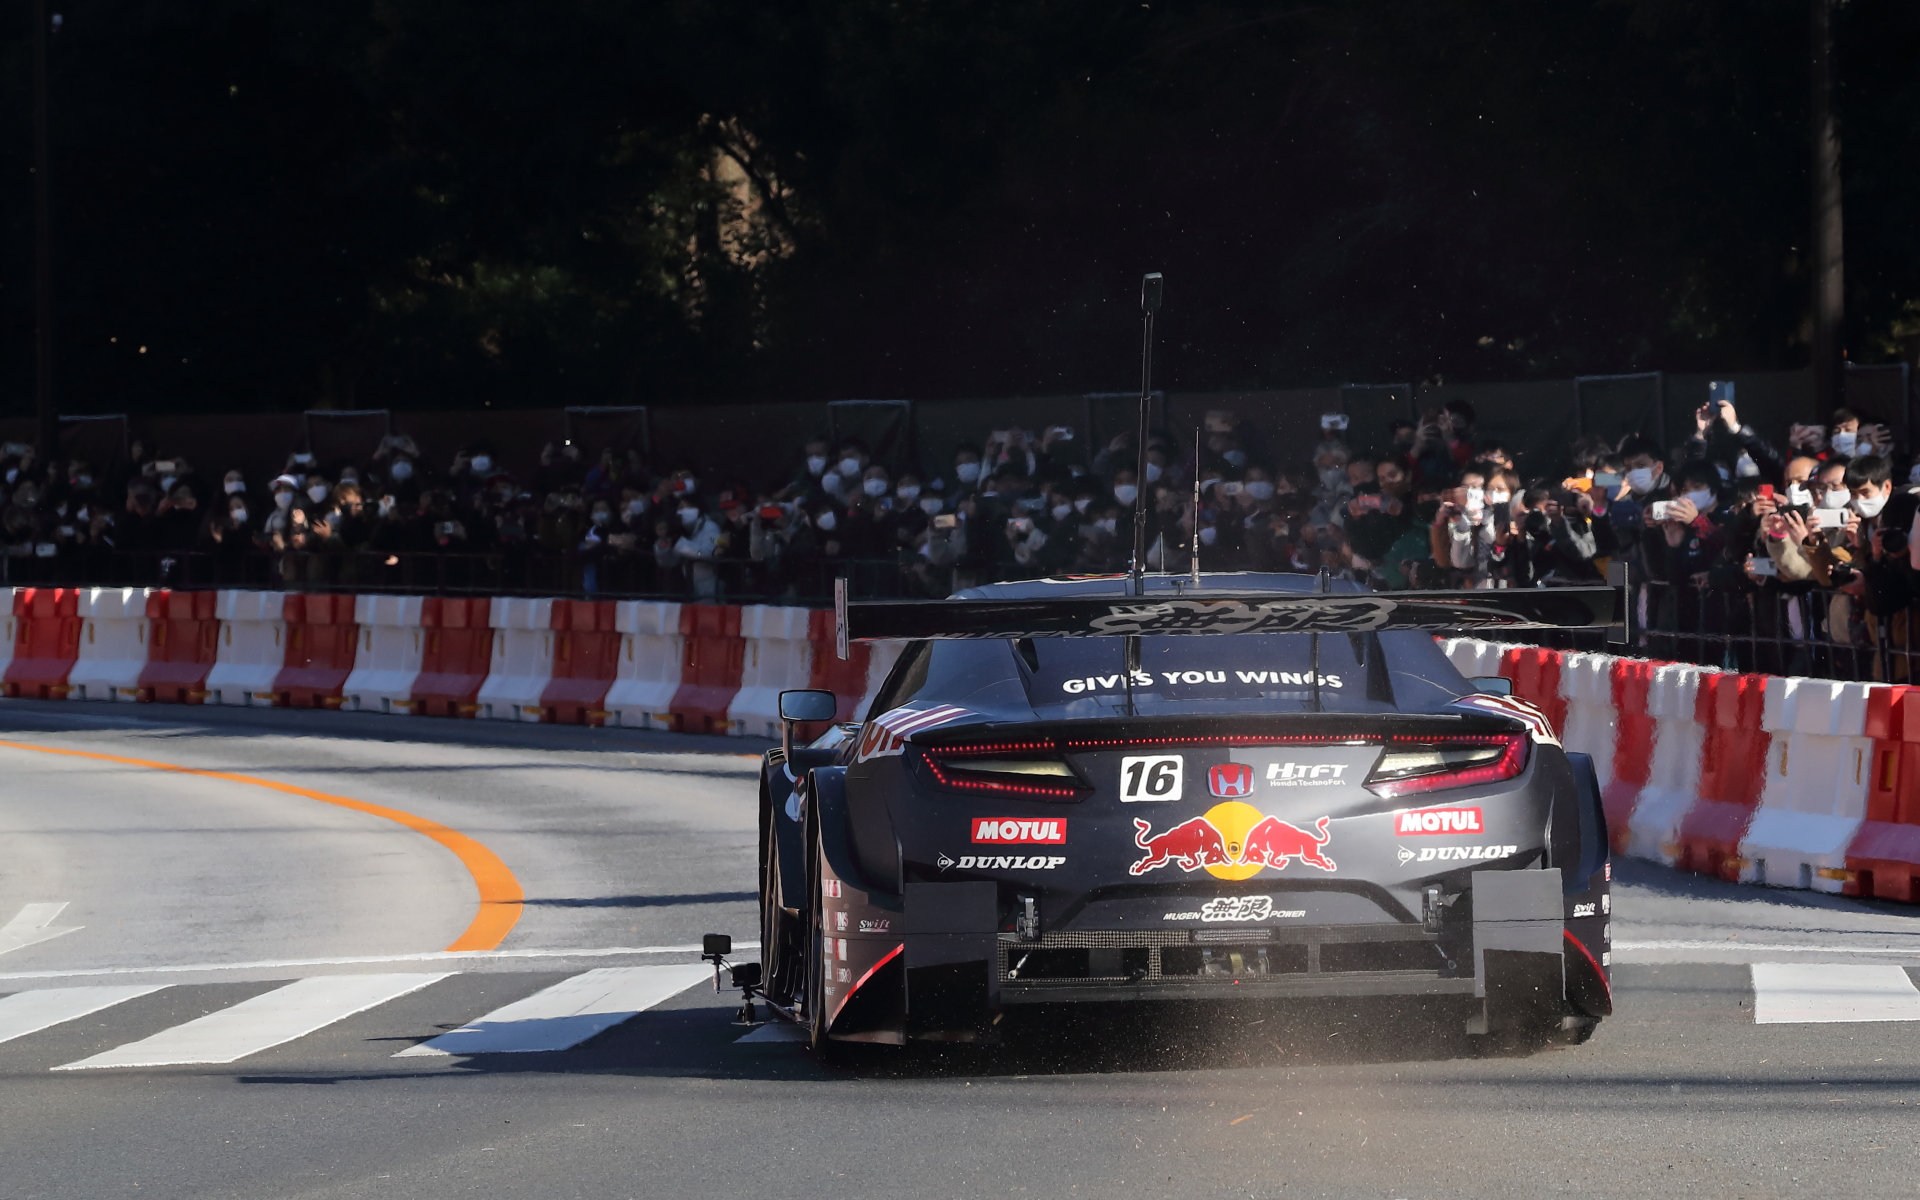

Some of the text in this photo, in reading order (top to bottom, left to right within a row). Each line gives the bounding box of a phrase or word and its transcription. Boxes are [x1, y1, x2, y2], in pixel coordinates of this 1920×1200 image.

[1161, 670, 1227, 685] YOU
[1126, 760, 1178, 796] 16
[1265, 762, 1349, 780] HTFT
[1270, 779, 1297, 787] Honda
[1400, 811, 1480, 832] MOTUL
[976, 820, 1062, 840] MOTUL
[1417, 845, 1518, 861] DUNLOP
[956, 856, 1067, 869] DUNLOP
[1163, 912, 1202, 921] MUGEN
[1269, 909, 1306, 919] POWER
[1574, 902, 1596, 913] Swift
[859, 919, 890, 929] Swift
